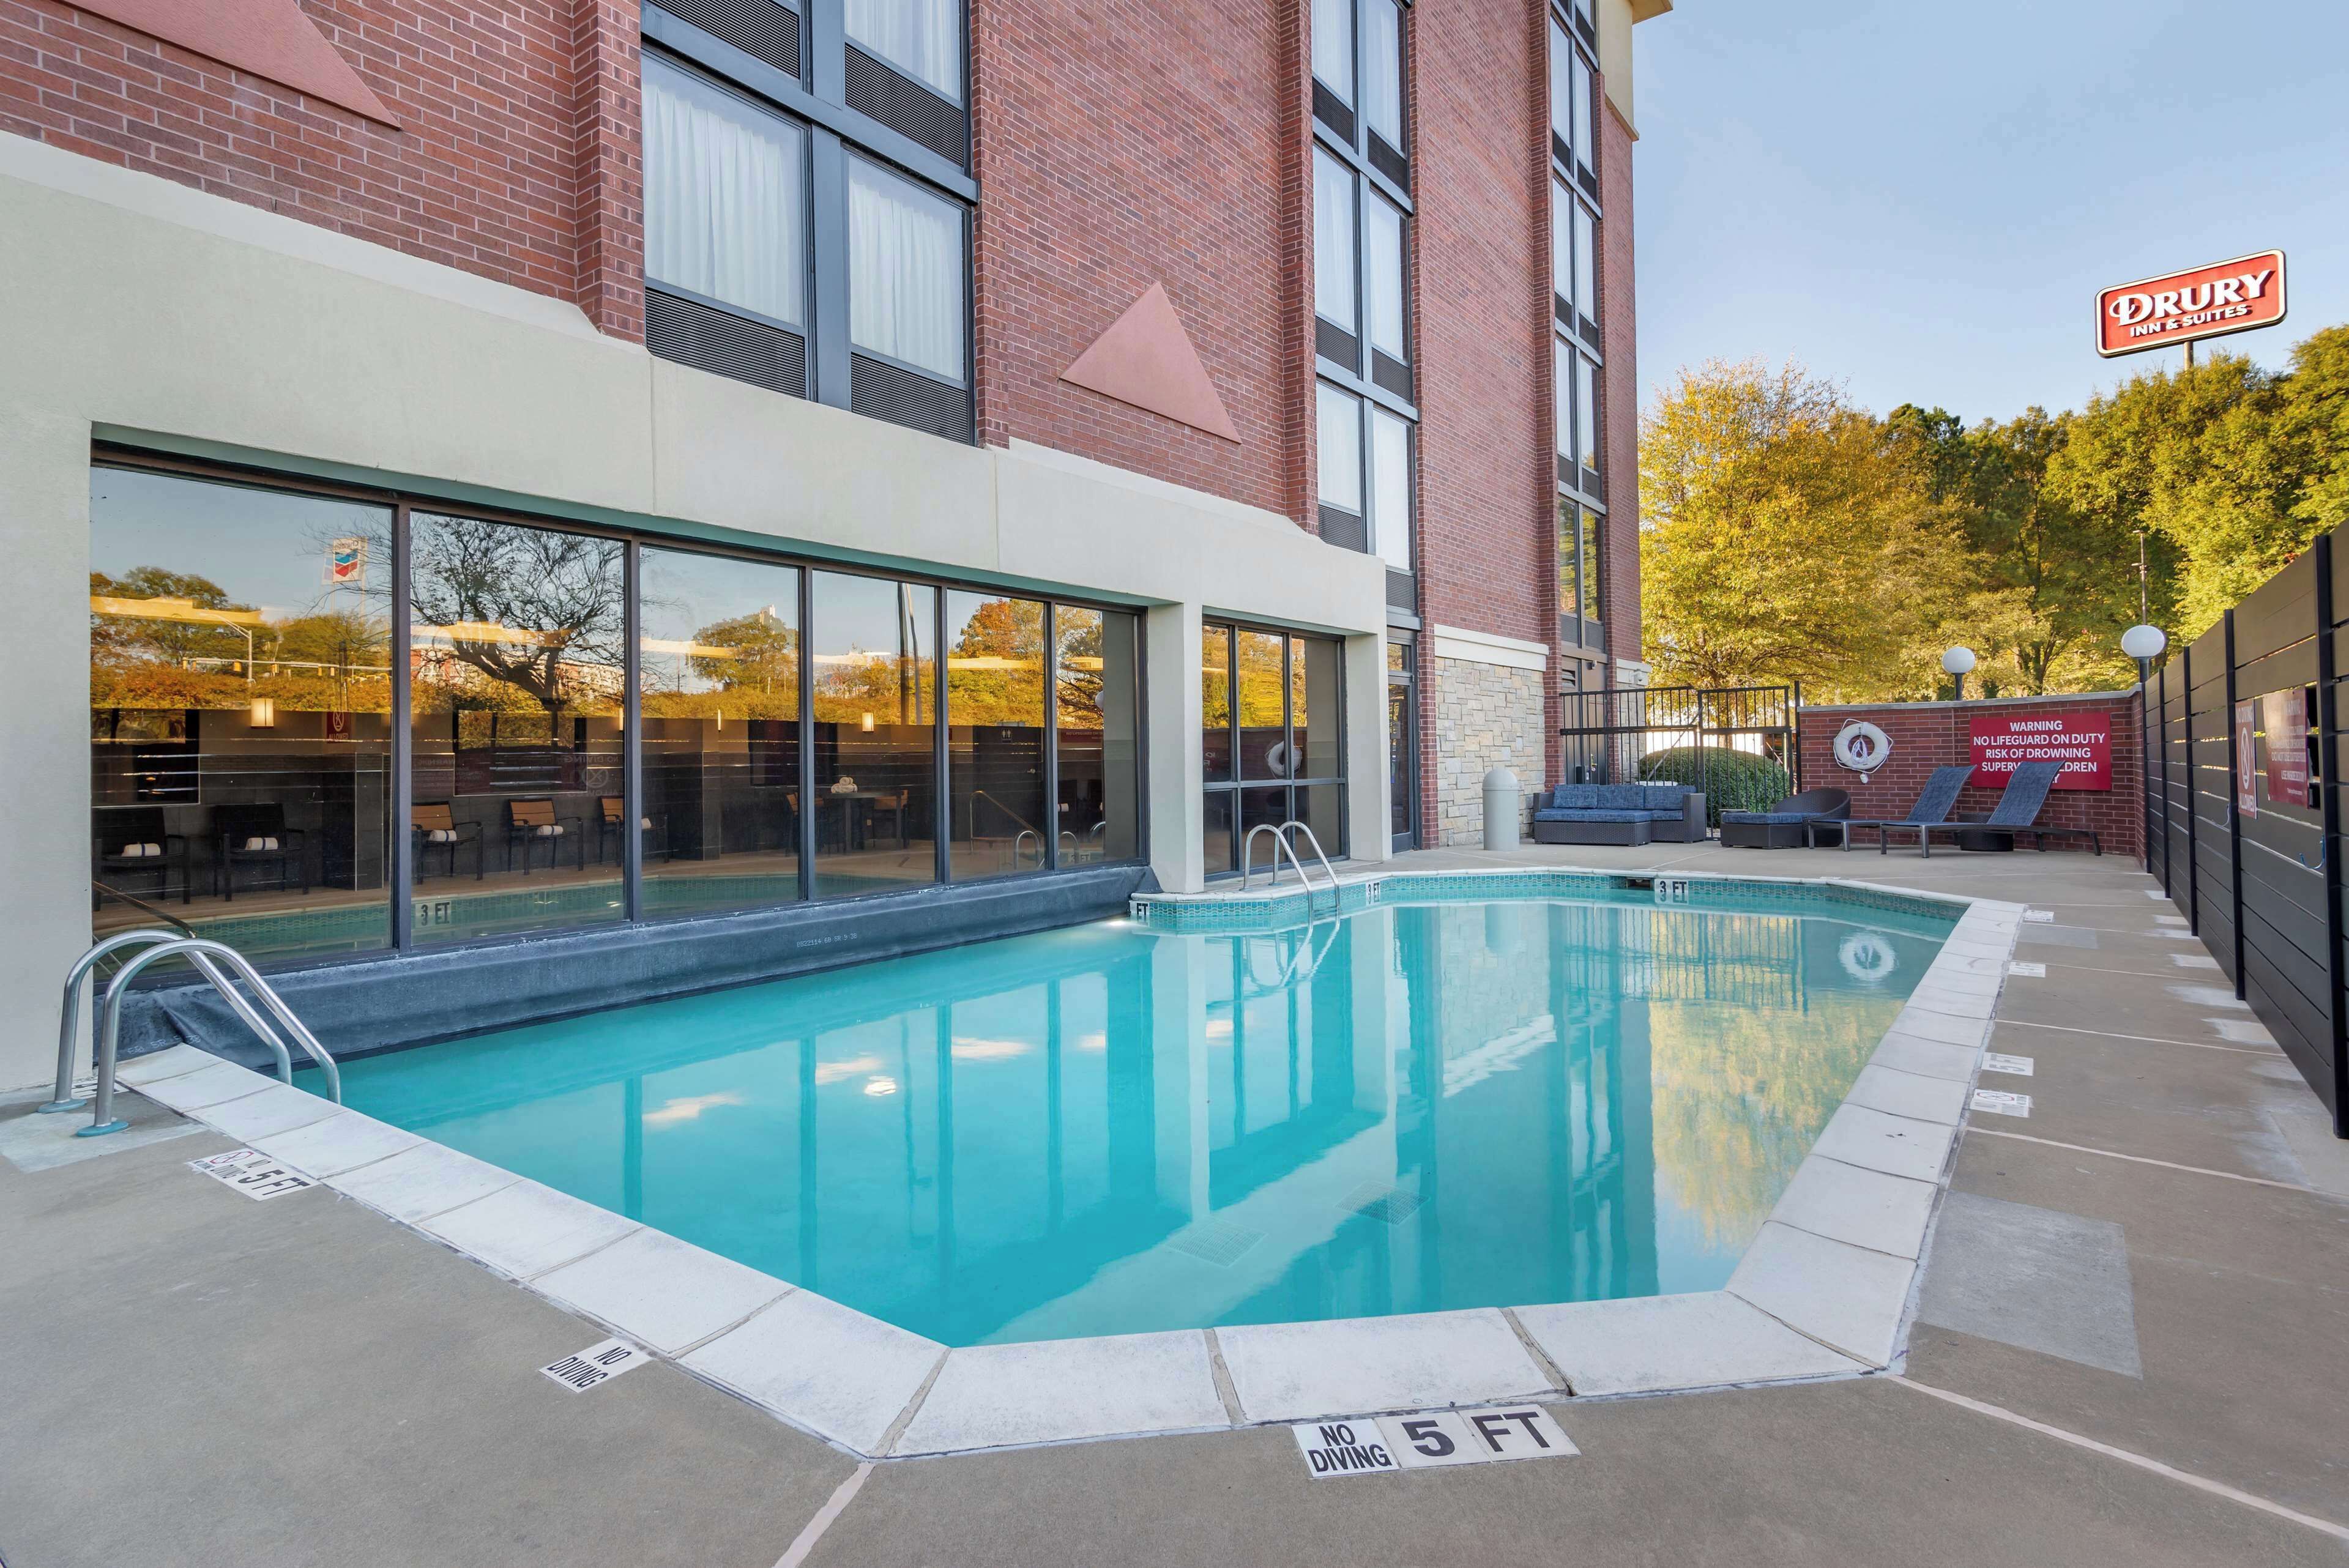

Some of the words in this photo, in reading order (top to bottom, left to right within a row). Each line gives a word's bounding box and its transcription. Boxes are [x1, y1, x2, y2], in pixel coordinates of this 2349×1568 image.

[2109, 270, 2271, 326] DRURY
[2129, 321, 2161, 338] INN
[2166, 319, 2180, 330] &
[2182, 303, 2249, 328] SUITES
[2010, 720, 2063, 732] WARNING
[1973, 736, 1989, 746] NO
[1991, 735, 2049, 746] LIFEGUARD
[2052, 734, 2069, 745] ON
[2072, 733, 2105, 744] DUTY
[1986, 748, 2008, 759] RISK
[2010, 748, 2024, 758] OF
[2027, 748, 2091, 759] DROWNING
[1374, 882, 1380, 895] FT
[1660, 881, 1666, 893] 3
[1672, 881, 1687, 893] FT
[1137, 903, 1148, 915] FT
[238, 1169, 285, 1183] 5
[251, 1176, 310, 1195] FT
[594, 1347, 632, 1365] NO
[546, 1356, 609, 1388] DIVING
[1319, 1424, 1356, 1447] NO
[1401, 1420, 1455, 1457] 5
[1471, 1411, 1550, 1452] FT
[1307, 1444, 1393, 1473] DIVING
